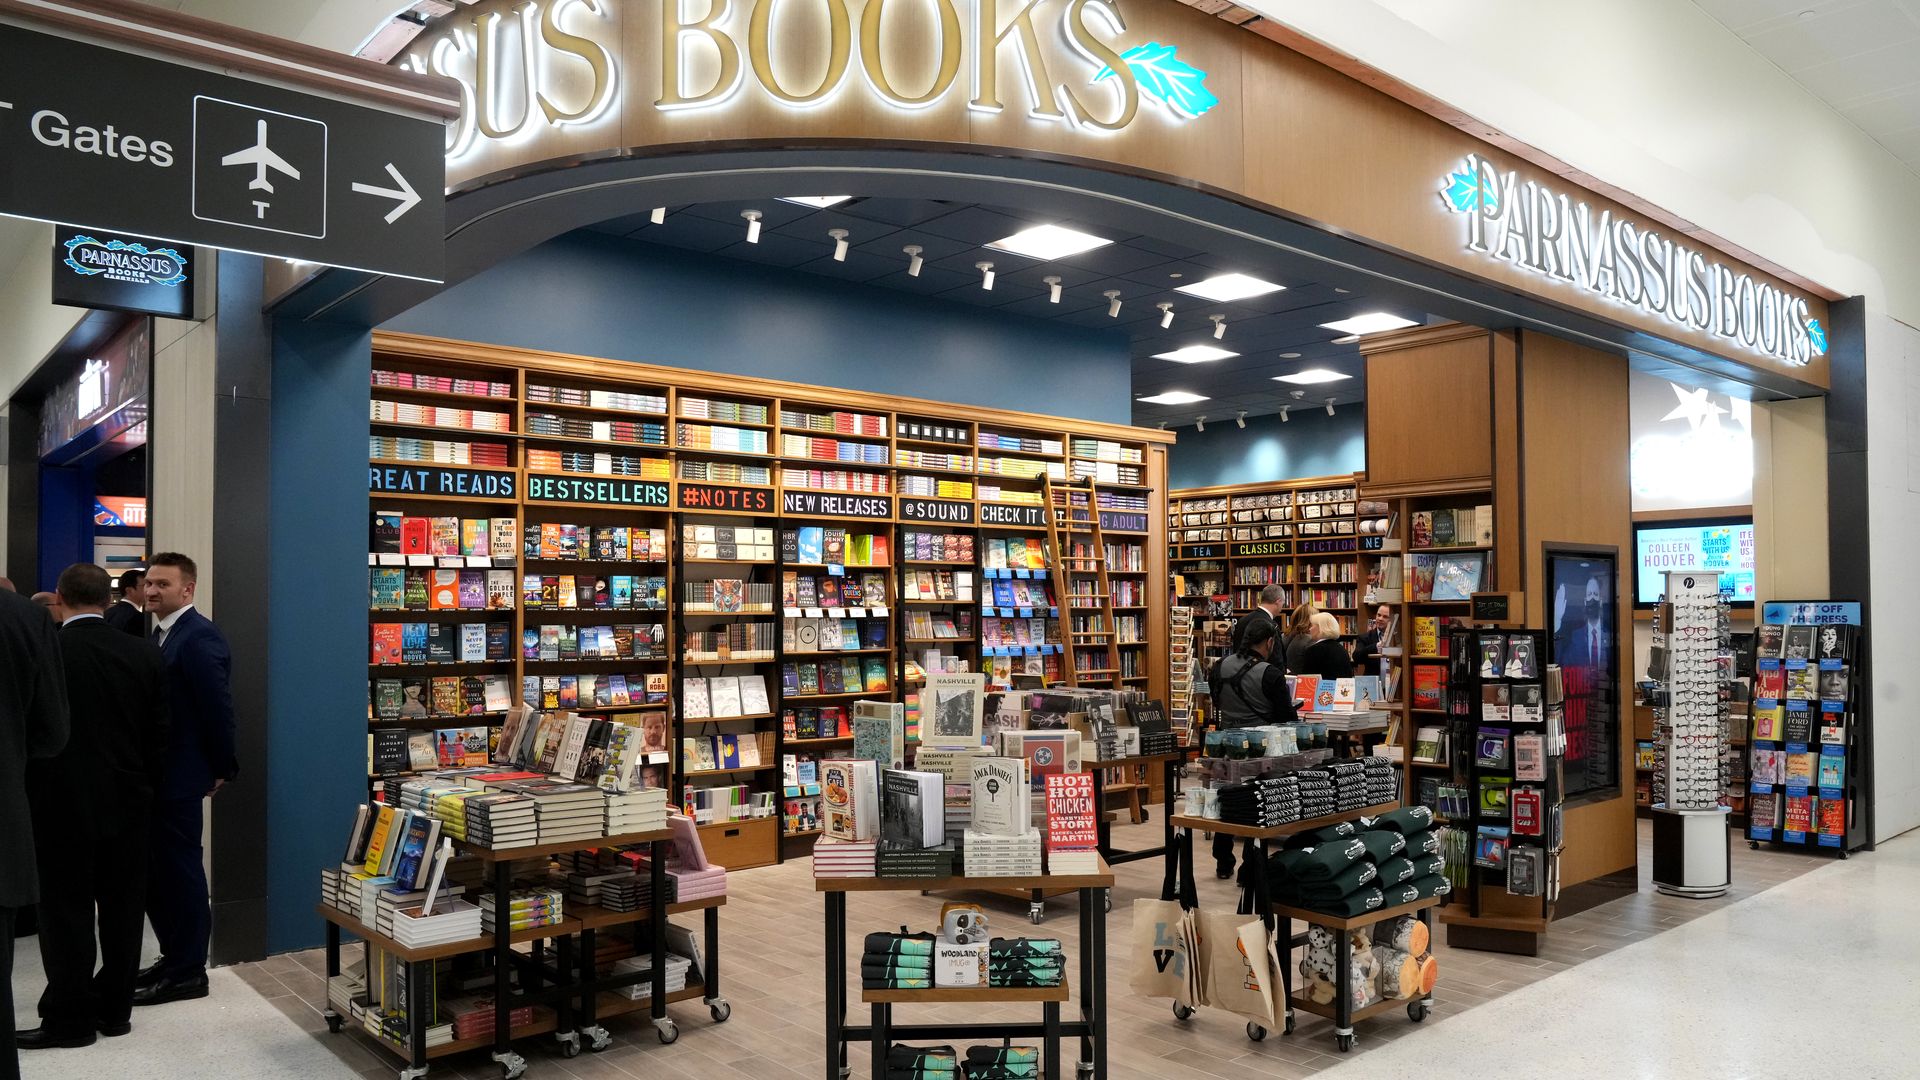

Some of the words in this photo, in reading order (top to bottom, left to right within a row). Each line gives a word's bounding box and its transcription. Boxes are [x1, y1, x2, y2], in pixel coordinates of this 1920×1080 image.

[655, 0, 1139, 138] BOOKS
[31, 110, 174, 168] Gates
[81, 248, 172, 274] PARNASSUS
[1466, 152, 1711, 330] PARNASSUS
[1712, 262, 1812, 366] BOOKS
[108, 267, 146, 279] BOOKS
[440, 472, 513, 496] READS
[529, 478, 668, 505] BESTSELLERS
[683, 487, 767, 509] #NOTES
[784, 495, 816, 512] NEW
[821, 497, 887, 516] RELEASES
[905, 503, 968, 521] @SOUND
[981, 506, 1021, 524] CHECK
[1026, 509, 1038, 524] IT
[1113, 515, 1145, 530] ADULT
[1240, 543, 1285, 555] CLASSICS
[1304, 540, 1356, 552] FICTION
[1649, 543, 1690, 553] COLLEEN
[1702, 538, 1726, 546] STARTS
[1193, 547, 1211, 557] TEA
[1644, 554, 1695, 567] HOOVER
[1796, 605, 1818, 613] HOT
[1757, 689, 1779, 699] Poet
[984, 714, 1020, 728] CASH
[1138, 711, 1160, 721] GUITAR
[974, 768, 988, 780] JACK
[989, 765, 1013, 784] DANIEL'S
[1049, 776, 1092, 786] HOT,
[889, 784, 917, 794] NASHVILLE
[1049, 787, 1091, 797] HOT
[1050, 797, 1093, 814] CHICKEN
